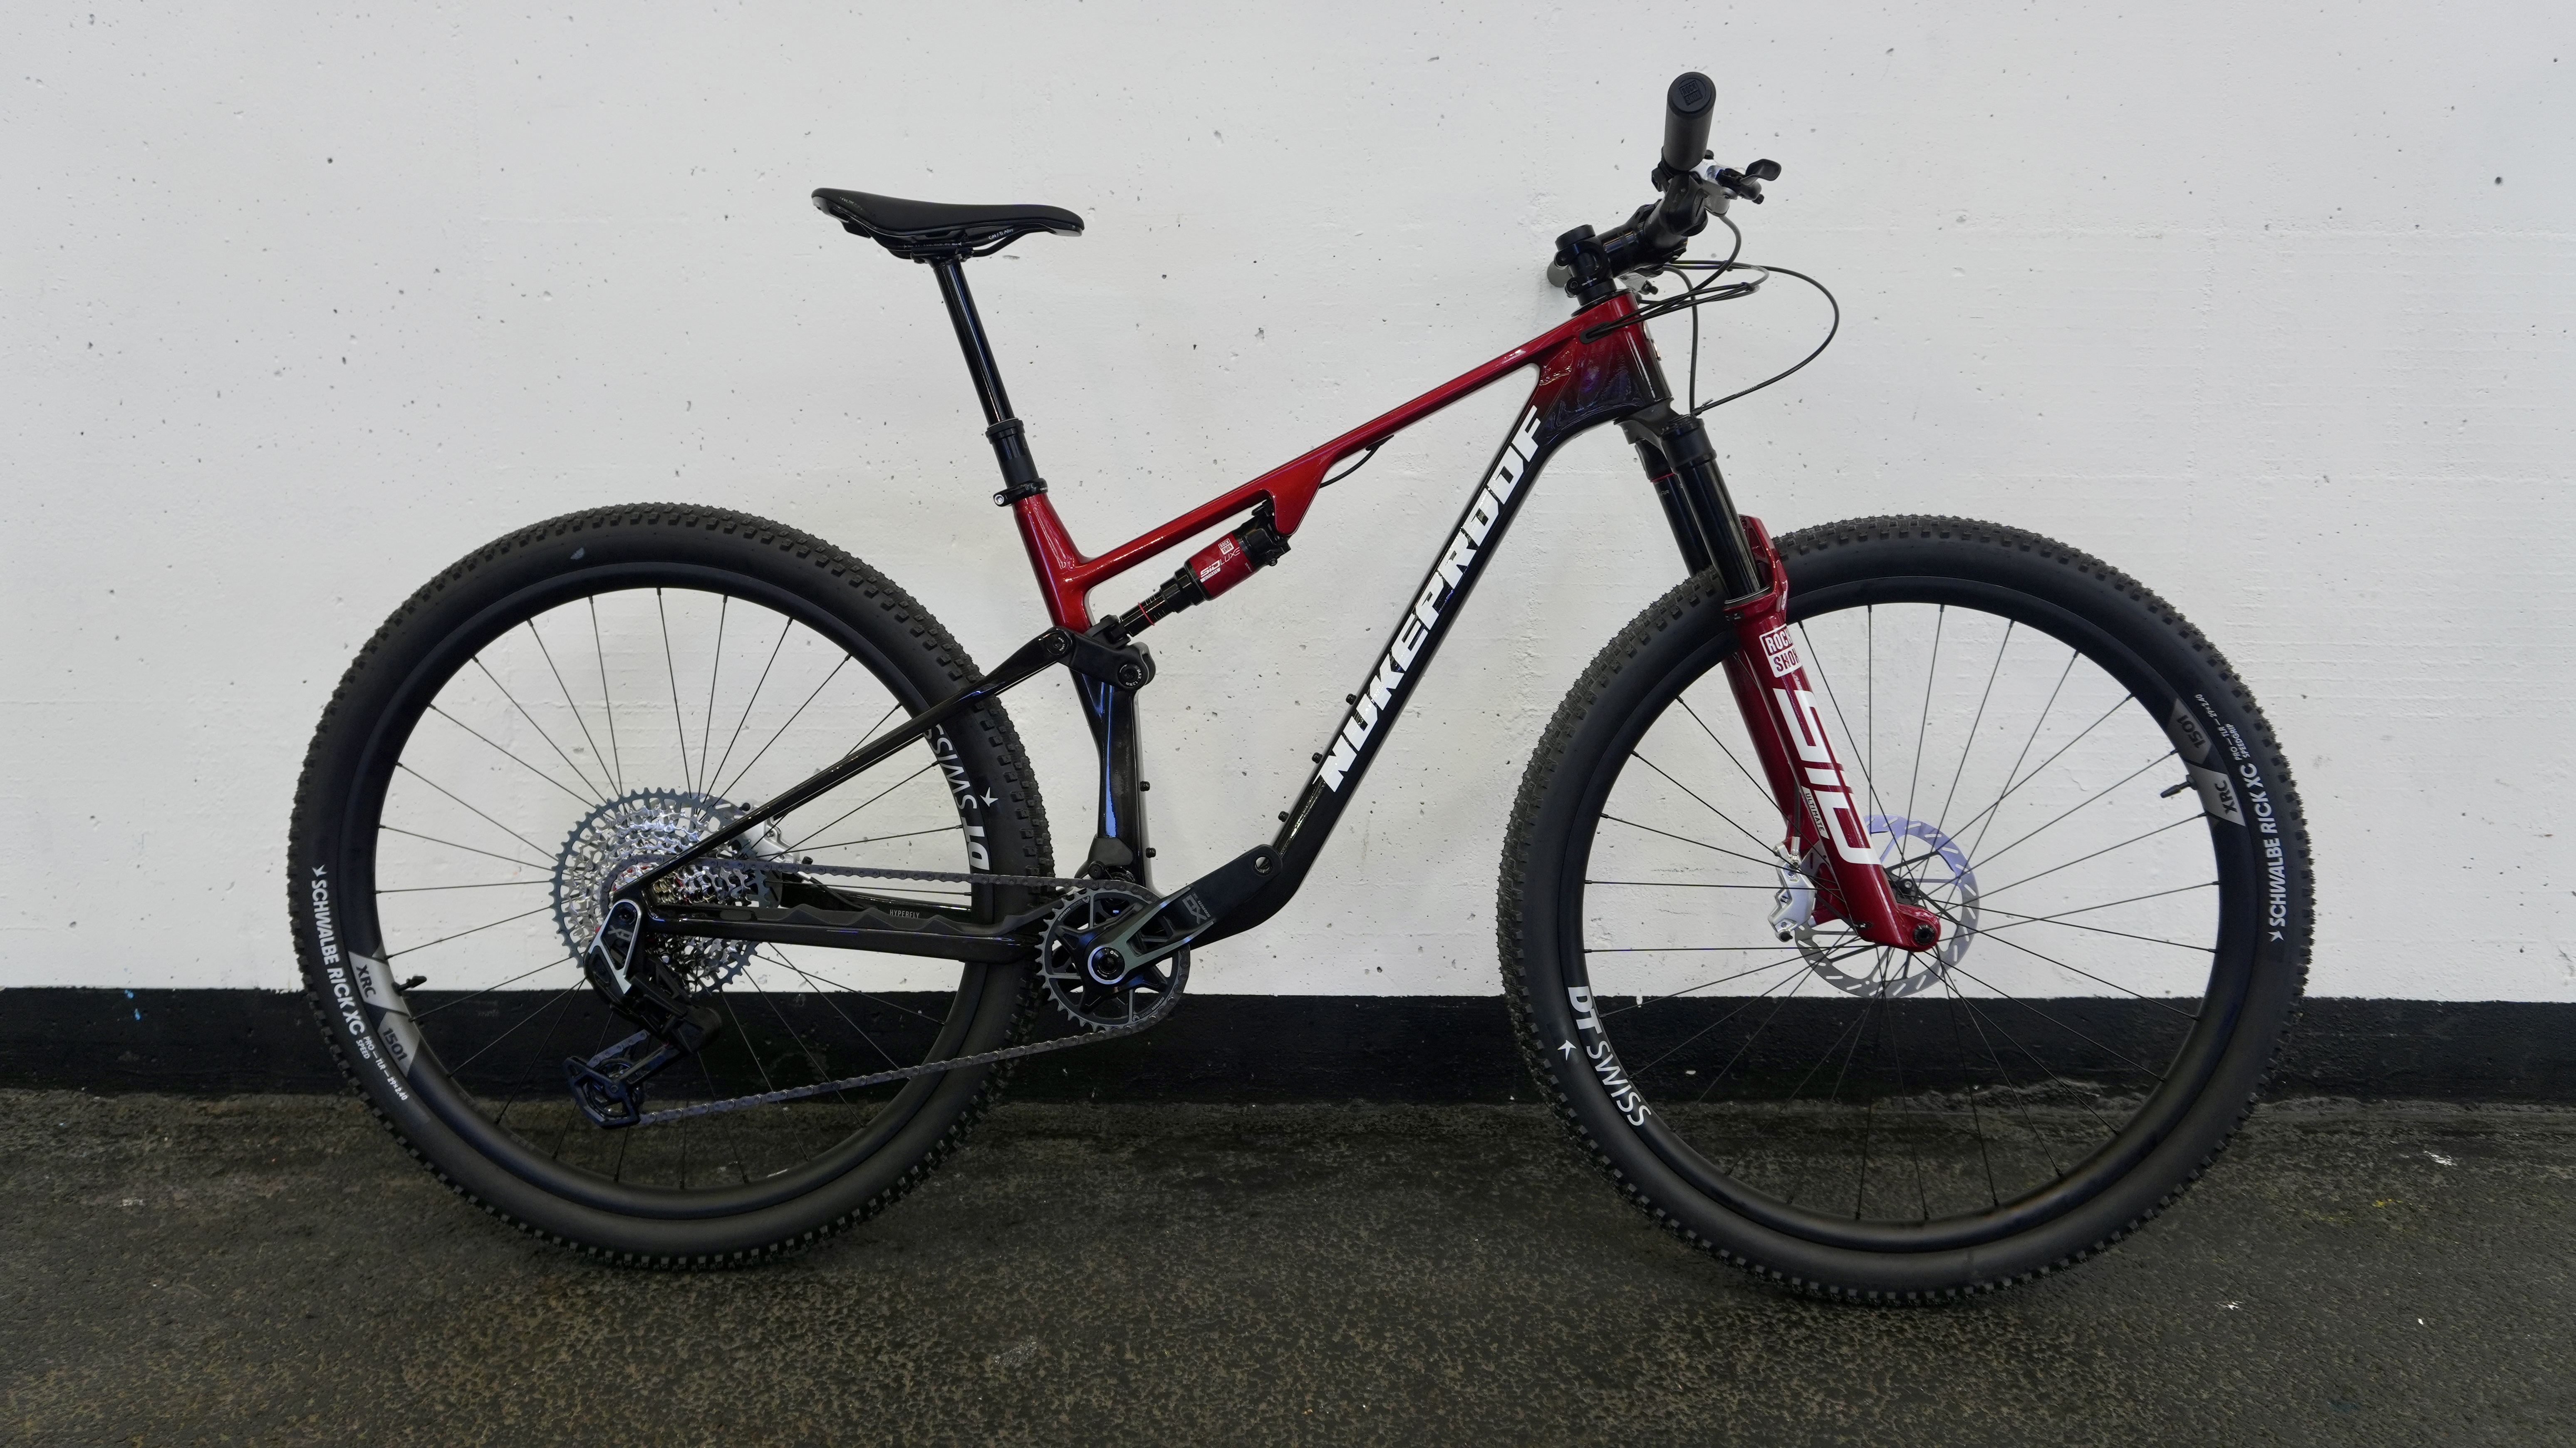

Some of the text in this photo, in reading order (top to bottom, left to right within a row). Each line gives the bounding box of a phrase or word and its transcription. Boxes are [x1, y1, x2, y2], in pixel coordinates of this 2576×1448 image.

[1219, 539, 1230, 548] ROCK
[1222, 544, 1232, 553] SHOX
[1204, 570, 1219, 580] ULTIMATE
[1312, 404, 1542, 793] NUKEPROOF
[1765, 628, 1793, 653] ROCK
[1773, 647, 1800, 672] SHOX
[2176, 715, 2206, 749] 1501
[2218, 726, 2230, 737] TLR
[2226, 723, 2251, 759] SPEEDGRIP
[2230, 746, 2242, 761] PRO
[1806, 793, 1825, 831] ULTIMATE
[2214, 780, 2237, 815] XRC
[961, 817, 990, 870] DT
[2240, 763, 2286, 927] SCHWALBE RICK XC
[889, 908, 920, 918] HYPERFLY
[1058, 907, 1071, 922] SRAM
[1198, 900, 1211, 917] SRAM
[311, 879, 365, 1035] SCHWALBE RICK XC
[355, 964, 376, 999] XRC
[1151, 996, 1164, 1011] SRAM
[356, 1039, 370, 1059] SPEED
[363, 1036, 374, 1051] PRO
[375, 1058, 386, 1070] TLR
[382, 1027, 408, 1061] 1501
[1567, 986, 1652, 1126] DT SWISS
